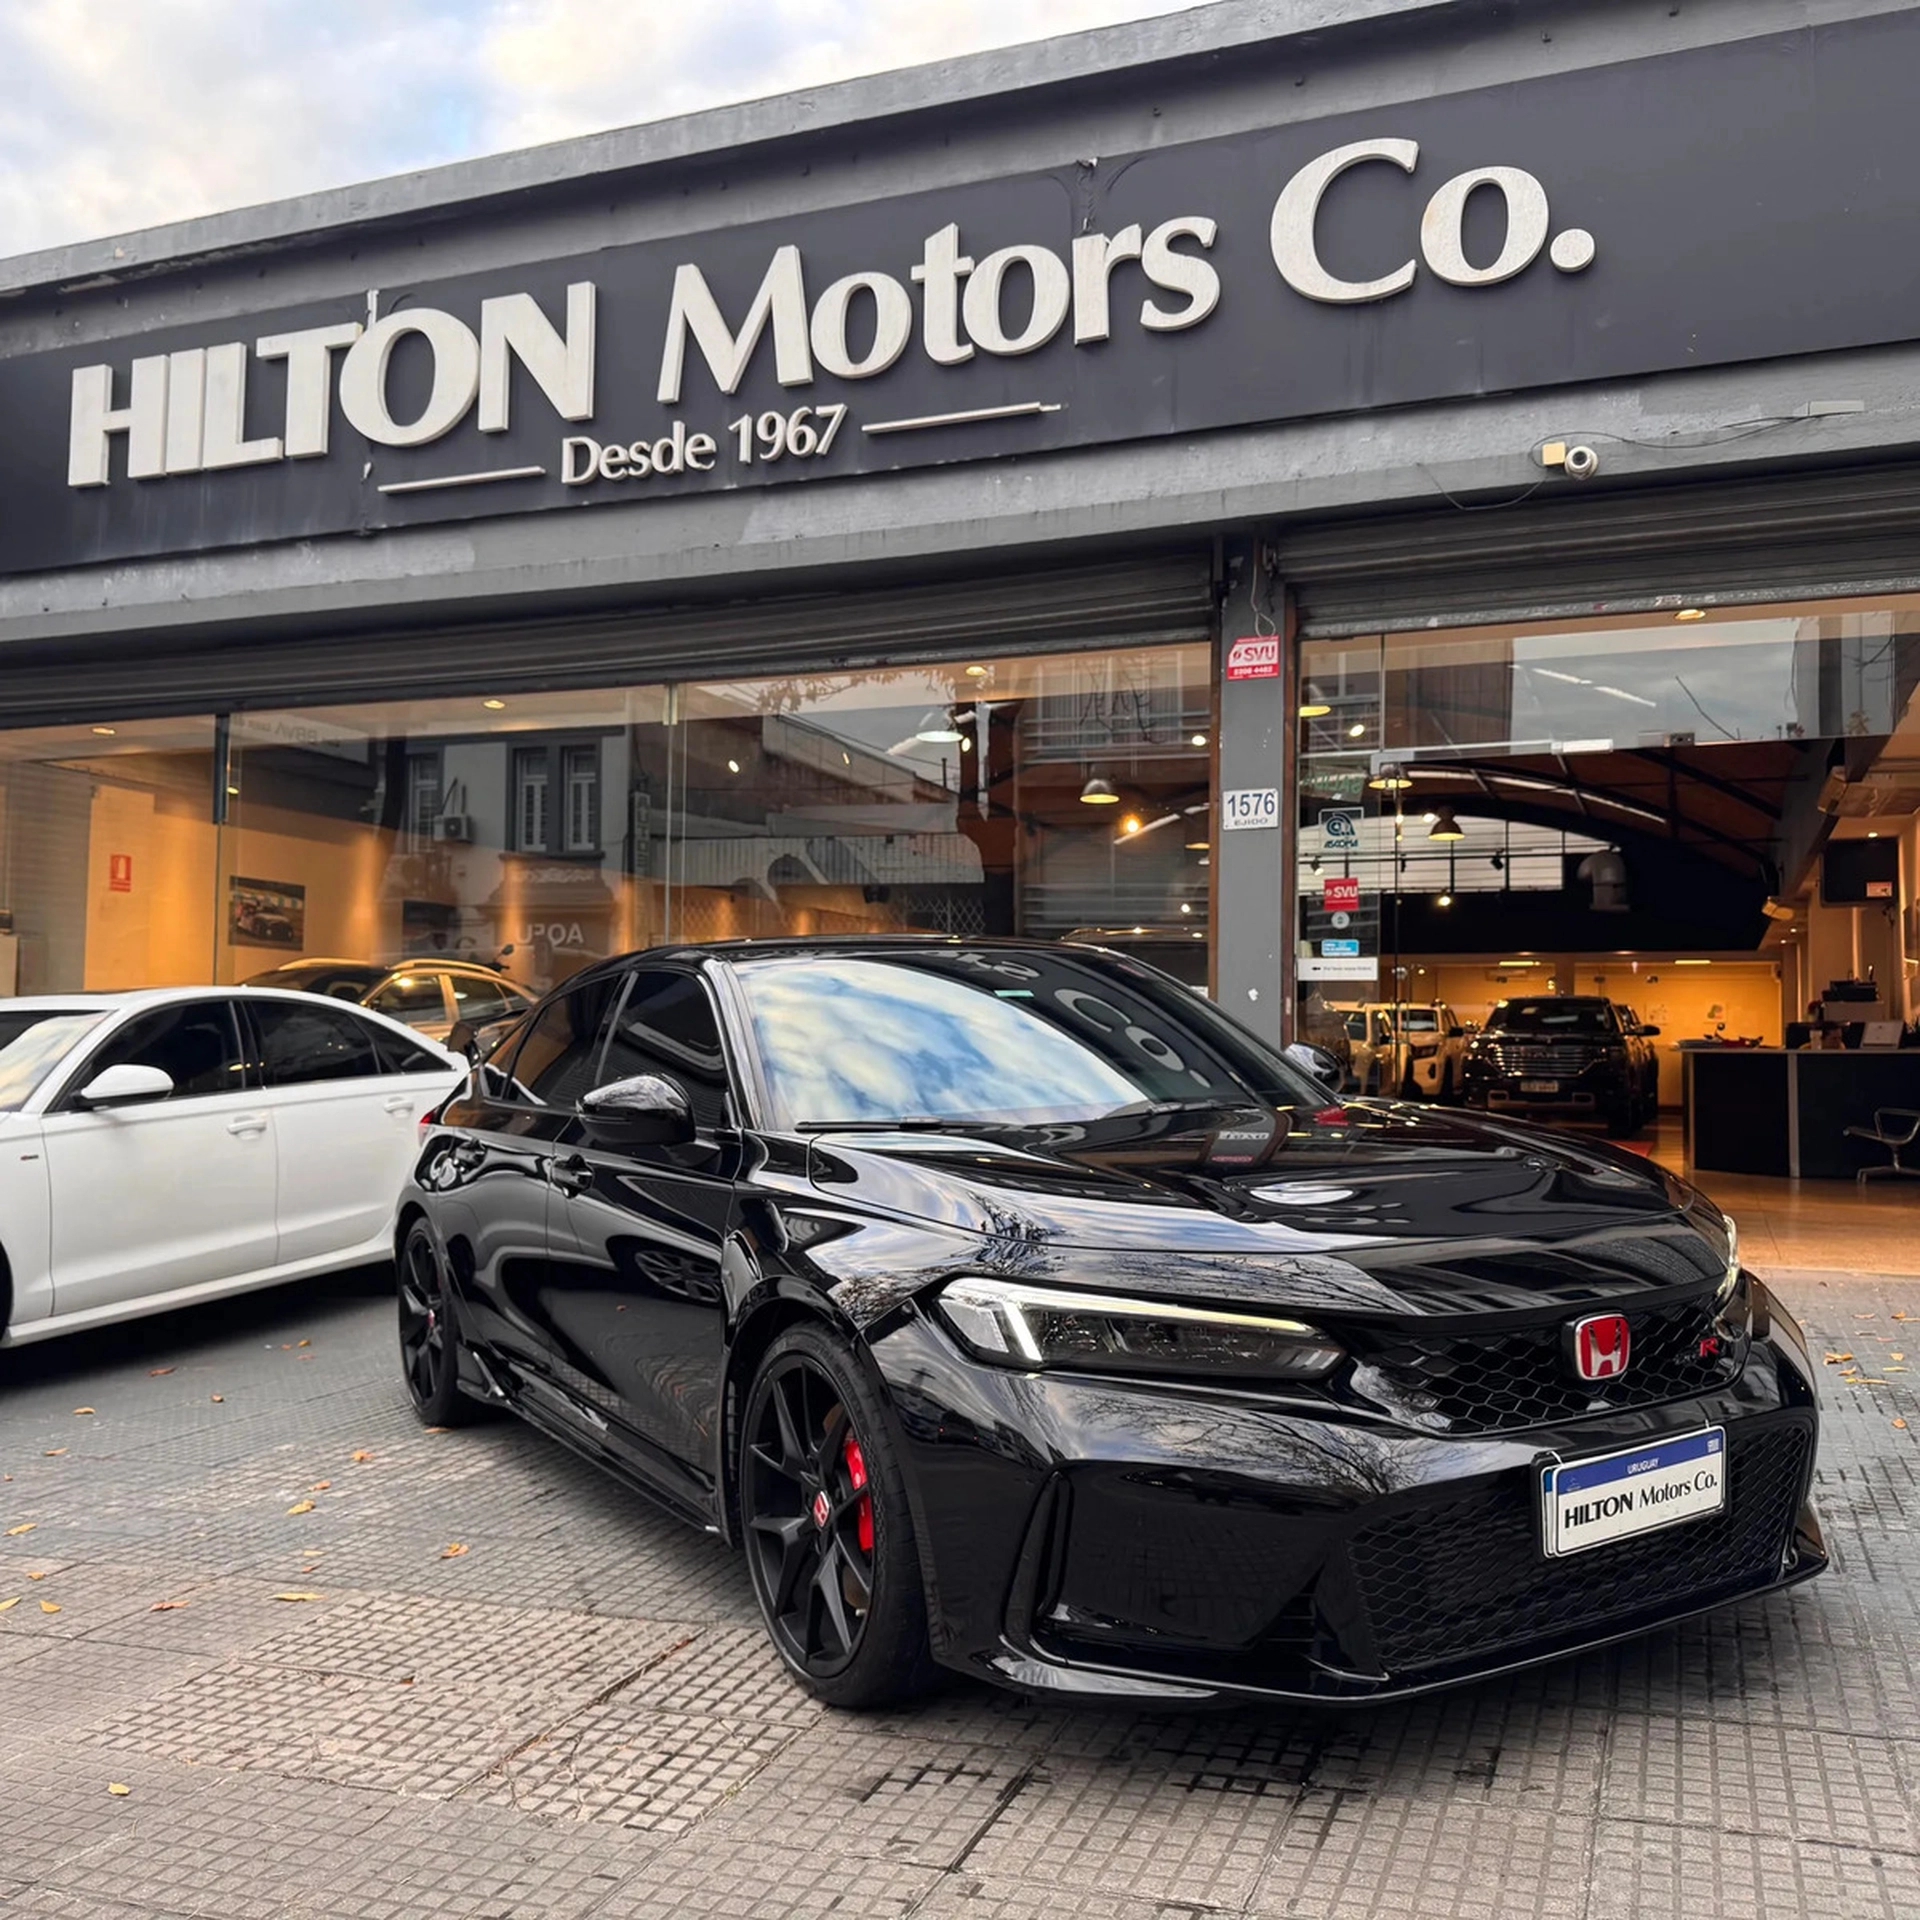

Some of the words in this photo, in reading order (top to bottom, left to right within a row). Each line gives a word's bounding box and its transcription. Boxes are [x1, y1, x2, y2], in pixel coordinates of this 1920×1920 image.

[68, 281, 596, 488] HILTON
[657, 216, 1220, 403] Motors
[1270, 137, 1596, 304] Co.
[561, 421, 717, 486] Desde
[728, 403, 848, 464] 1967
[1244, 645, 1276, 661] SVU
[1228, 791, 1276, 818] 1576
[1234, 817, 1269, 827] EJIDO
[1333, 885, 1358, 899] SVU
[1626, 1457, 1660, 1475] URUGUAY
[1564, 1491, 1634, 1530] HILTON
[1639, 1479, 1692, 1509] Motors
[1693, 1470, 1719, 1492] Co.
